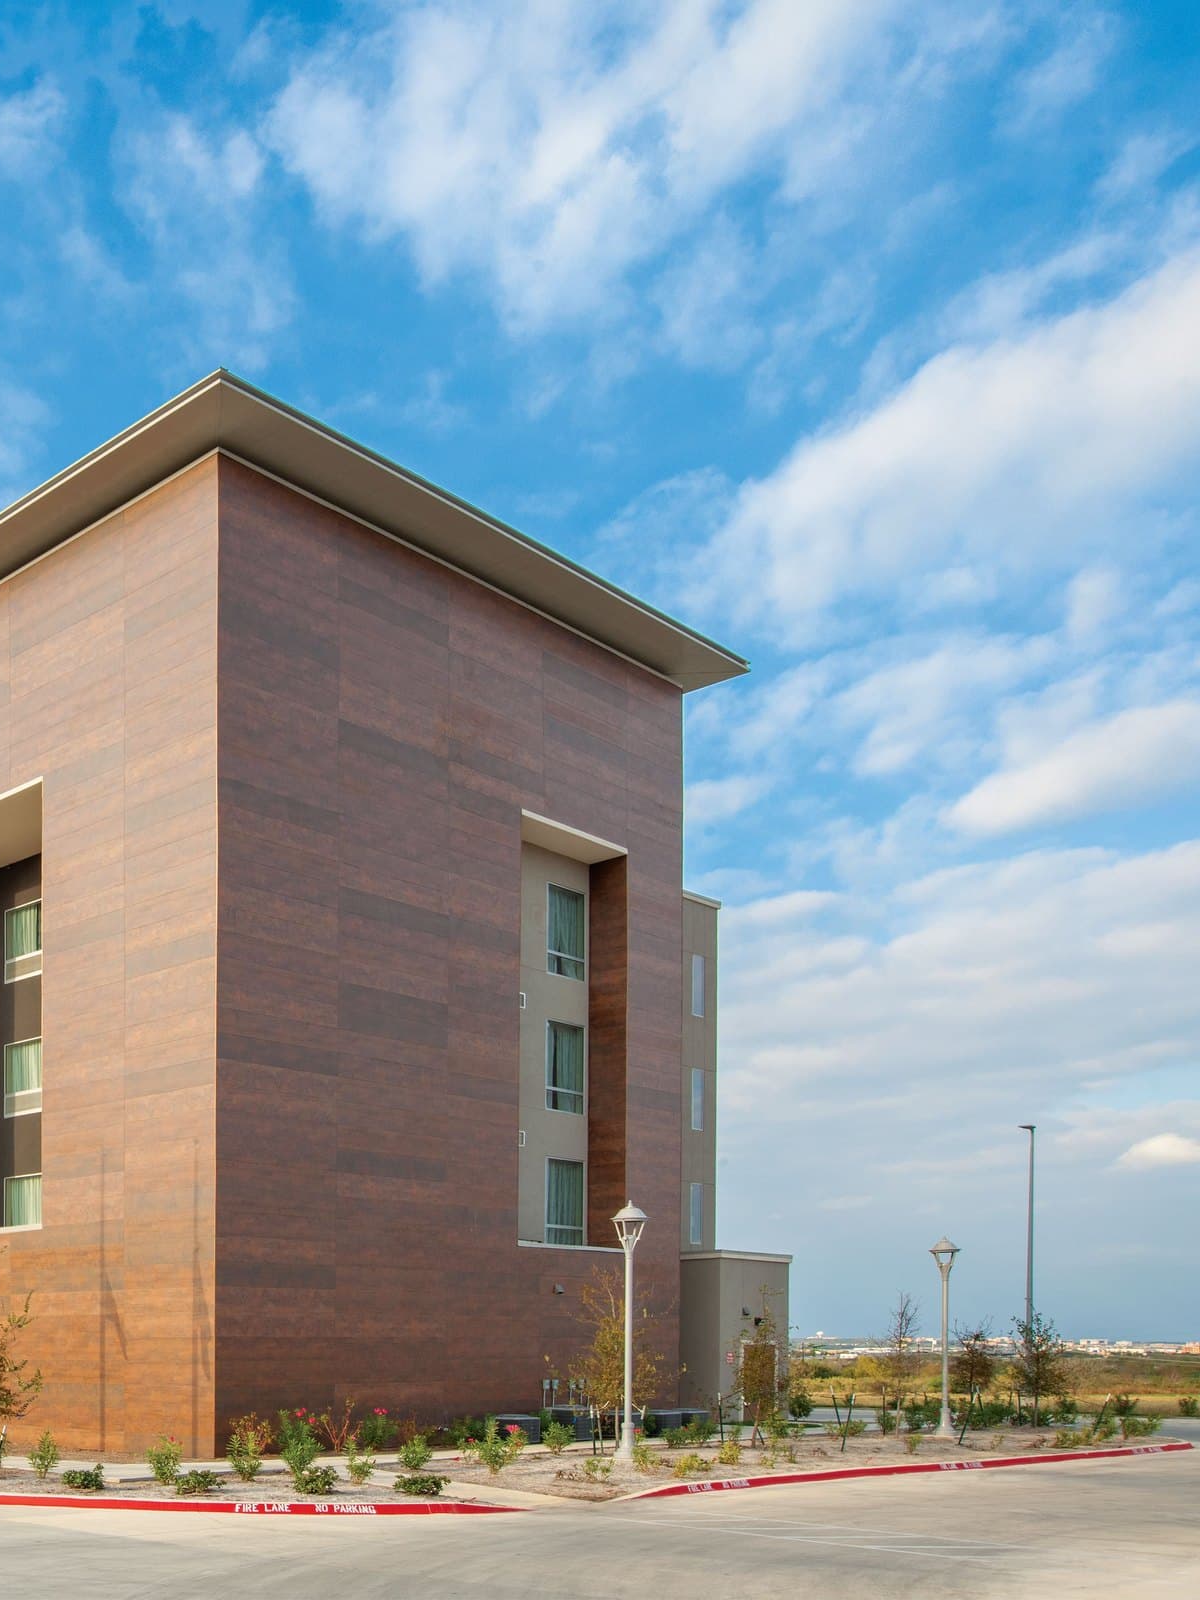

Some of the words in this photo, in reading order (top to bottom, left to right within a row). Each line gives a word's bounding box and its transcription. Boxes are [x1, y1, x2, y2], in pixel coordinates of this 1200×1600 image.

[235, 1503, 260, 1513] FIRE
[264, 1503, 292, 1513] LANE
[315, 1503, 329, 1513] NO
[333, 1503, 377, 1514] PARKING
